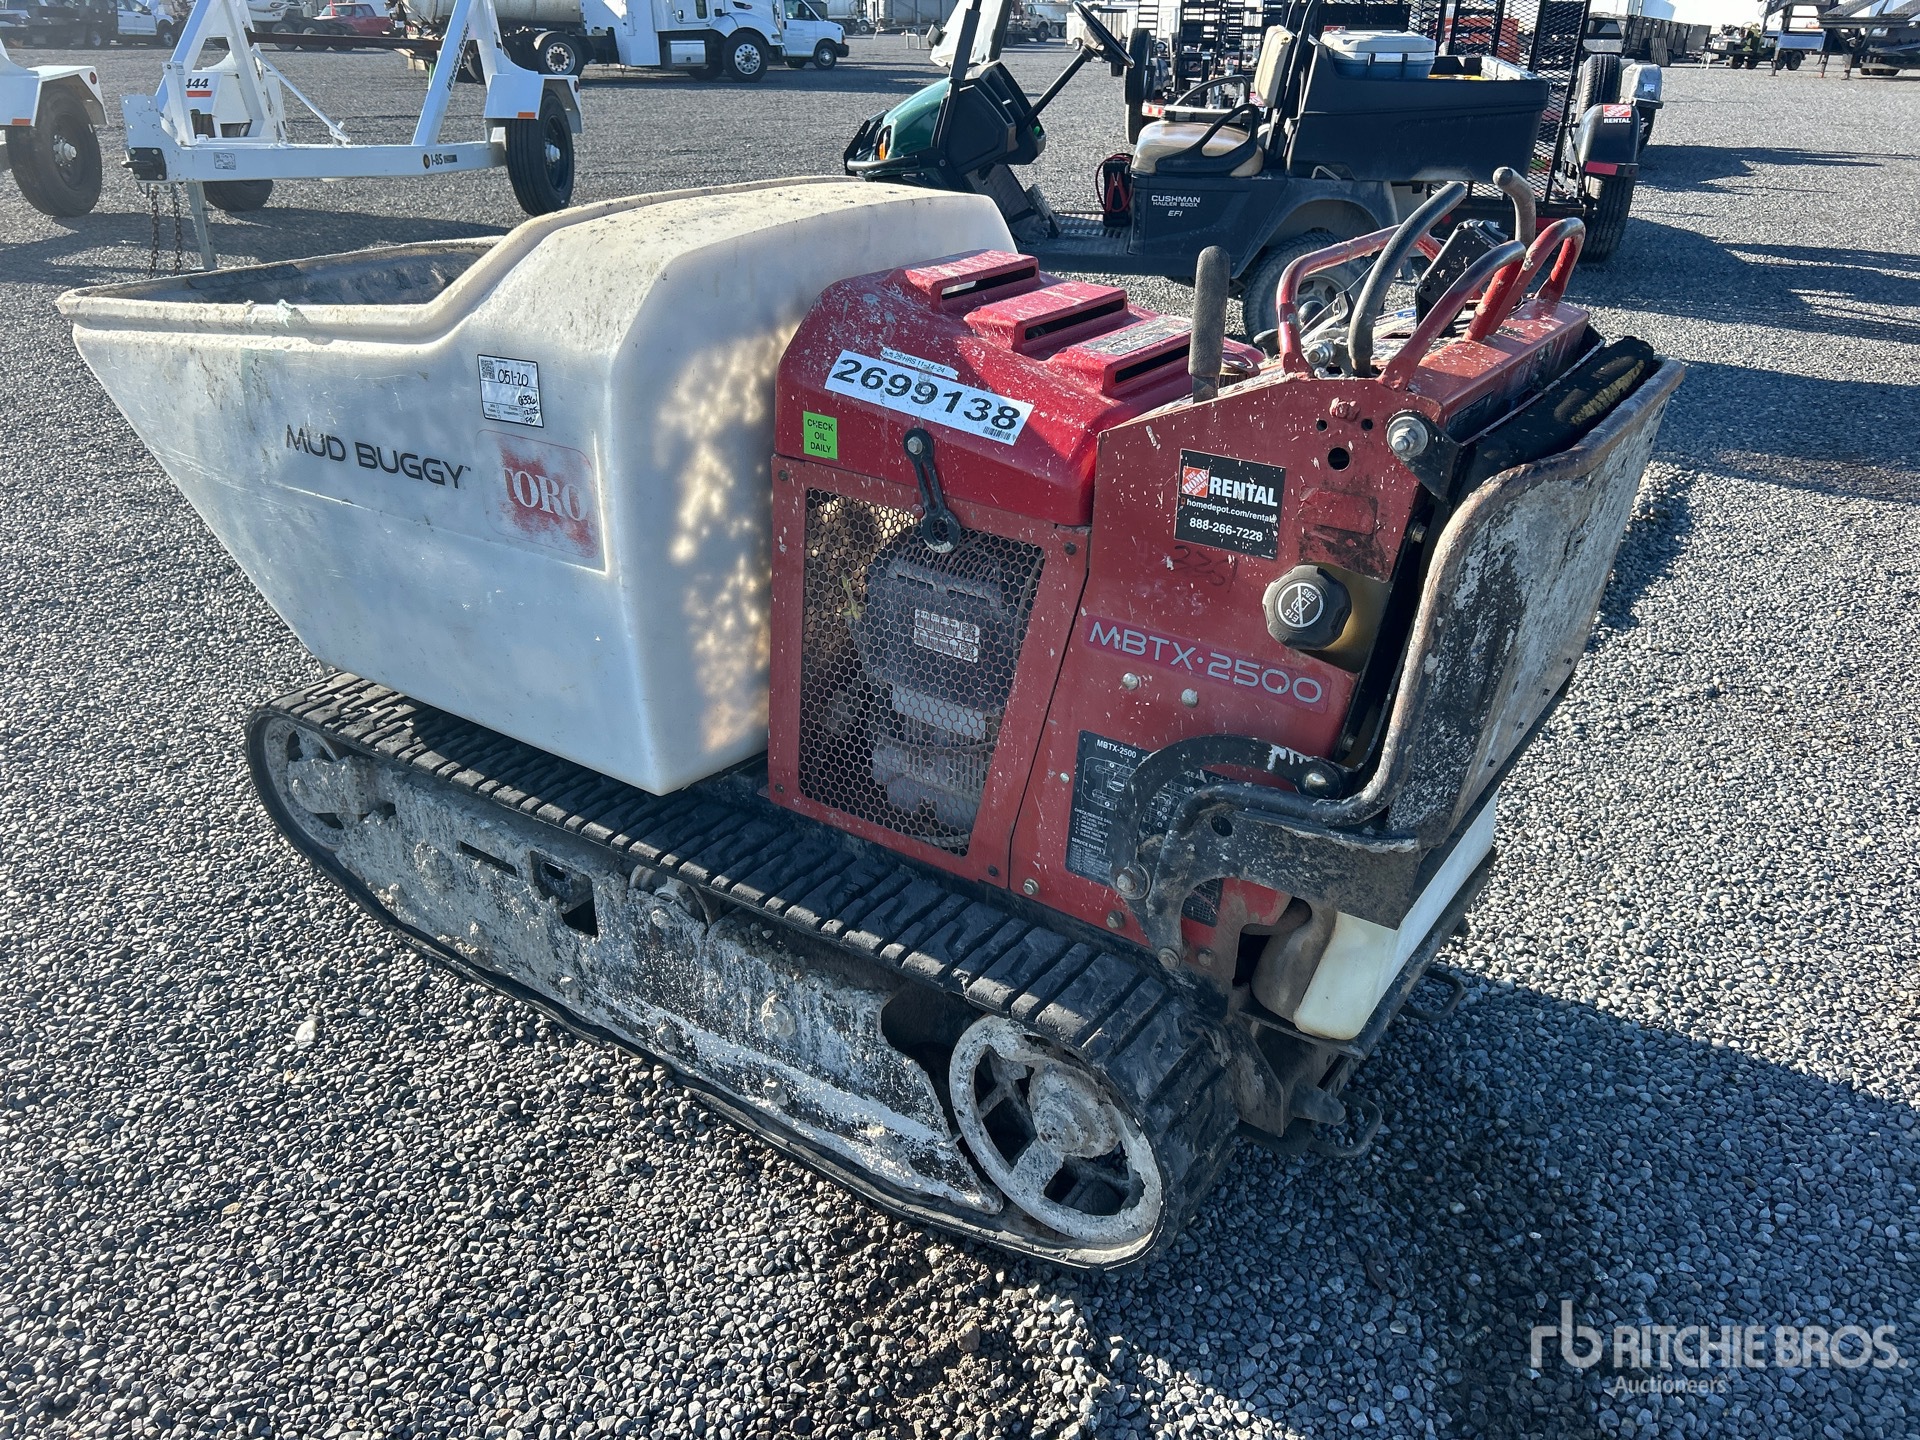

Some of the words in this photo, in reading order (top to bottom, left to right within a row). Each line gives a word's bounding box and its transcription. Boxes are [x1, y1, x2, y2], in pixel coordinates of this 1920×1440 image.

[1151, 195, 1201, 203] CUSHMAN
[903, 355, 917, 366] HRS
[831, 358, 1021, 431] 2699138
[807, 418, 834, 432] CHECK
[286, 424, 347, 462] MUD
[814, 431, 827, 442] OIL
[810, 441, 832, 453] DAILY
[1182, 469, 1209, 494] HOME
[1209, 476, 1278, 507] RENTAL
[1189, 517, 1264, 542] 888-266-7228
[1301, 588, 1317, 602] E85
[1284, 608, 1299, 622] E15
[1096, 739, 1137, 759] MBTX-2500
